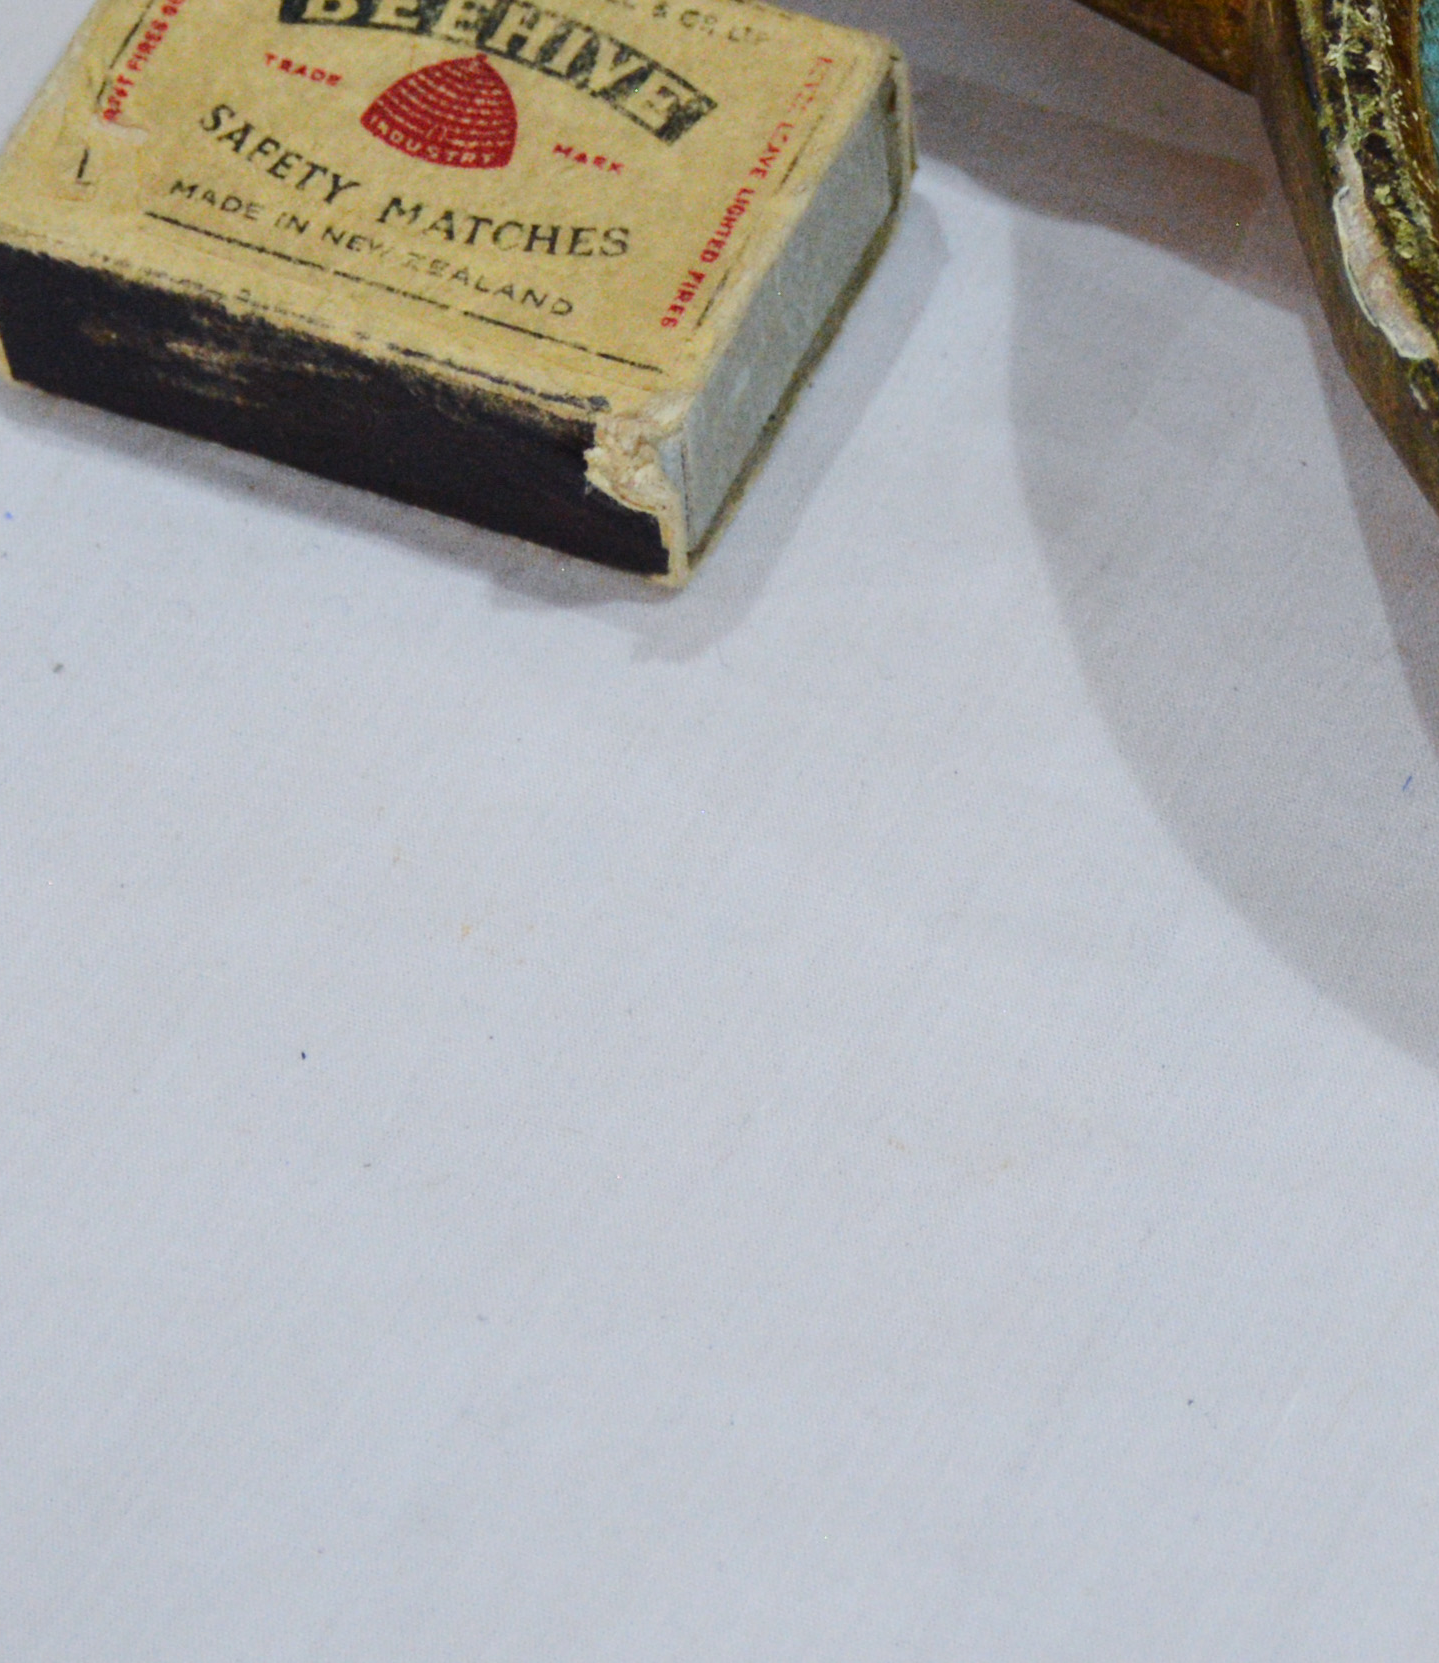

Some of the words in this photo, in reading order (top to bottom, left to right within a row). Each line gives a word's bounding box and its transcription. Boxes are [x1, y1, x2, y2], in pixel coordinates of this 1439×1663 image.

[126, 19, 168, 72] FIRES
[263, 53, 343, 87] TRADE
[368, 114, 496, 164] INDUSTRY
[552, 143, 626, 176] MARK
[199, 102, 361, 205] SAFETY
[376, 197, 633, 257] MATCHES
[170, 179, 262, 222] MADE
[275, 212, 311, 236] IN
[321, 225, 390, 258] NEW
[398, 250, 575, 317] ZEALAND
[700, 187, 755, 264] LIGHTED
[660, 268, 707, 329] FIRES
